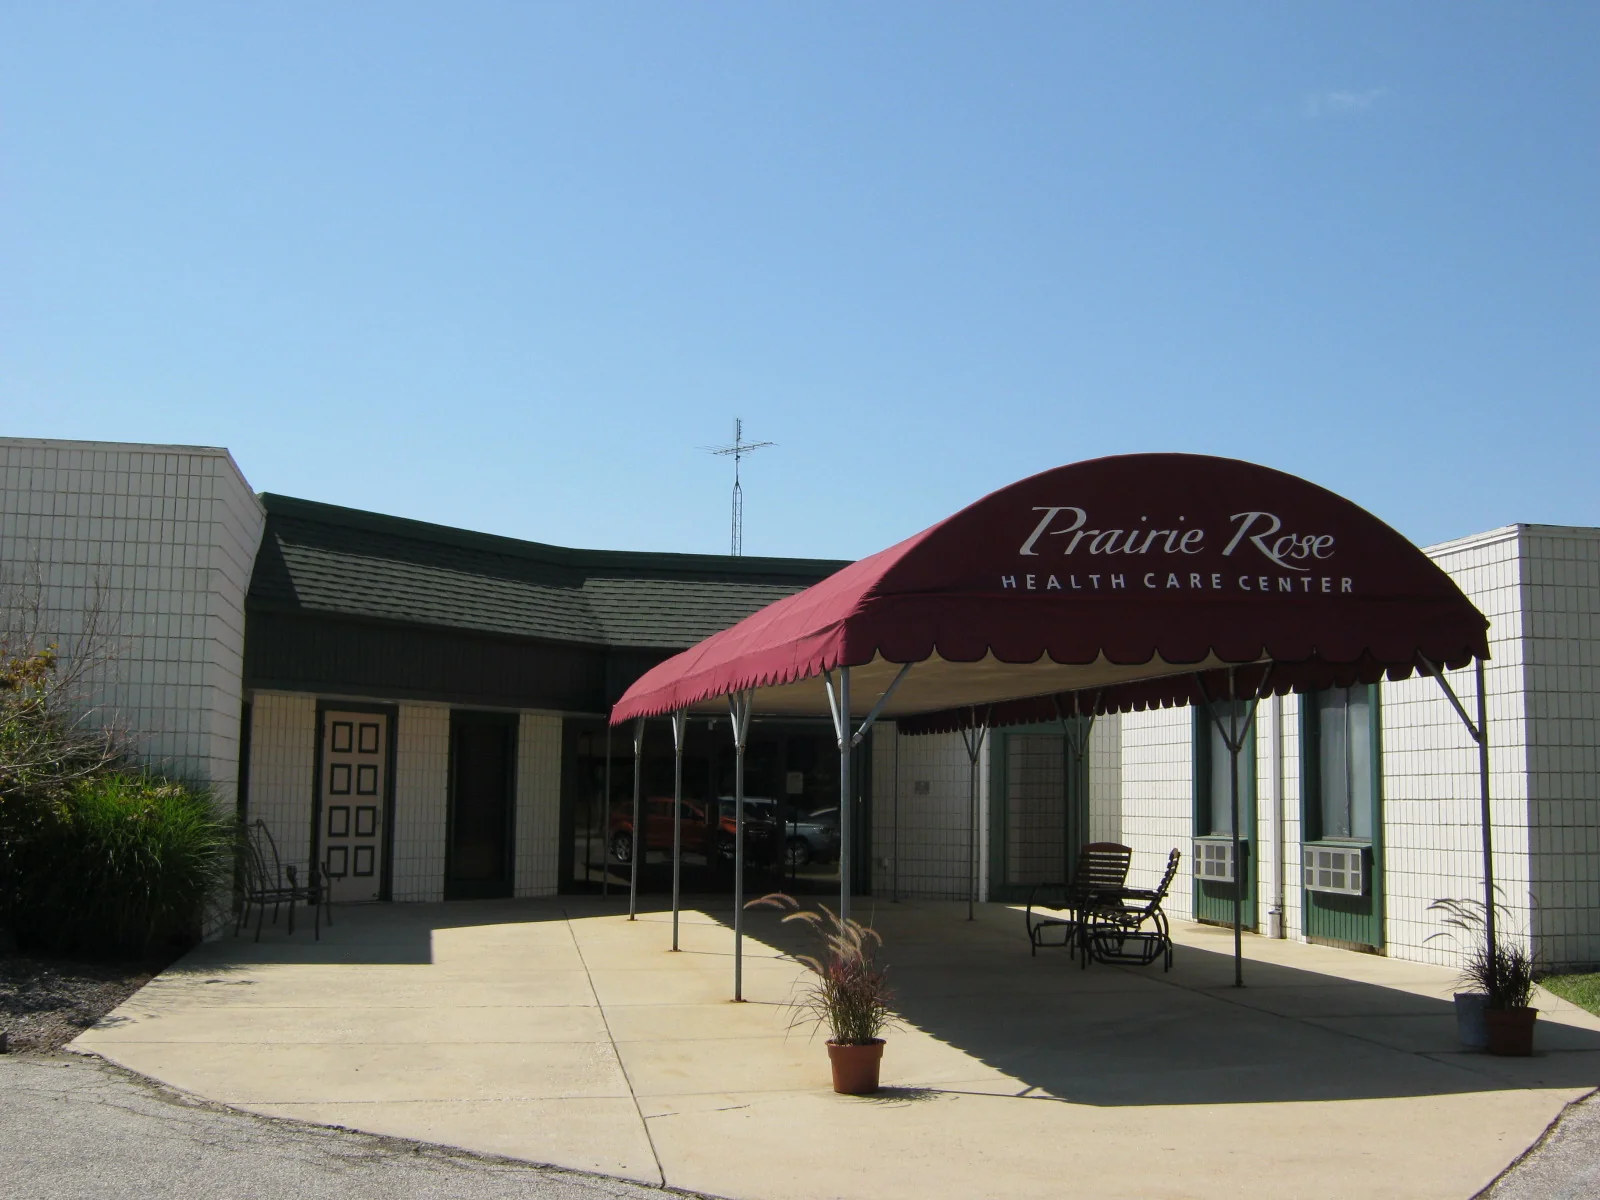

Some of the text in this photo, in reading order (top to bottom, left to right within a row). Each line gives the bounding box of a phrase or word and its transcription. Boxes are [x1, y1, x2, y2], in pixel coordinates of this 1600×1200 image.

[1019, 506, 1335, 571] Prairie Rose
[1001, 573, 1353, 593] HEALTH CARE CENTER
